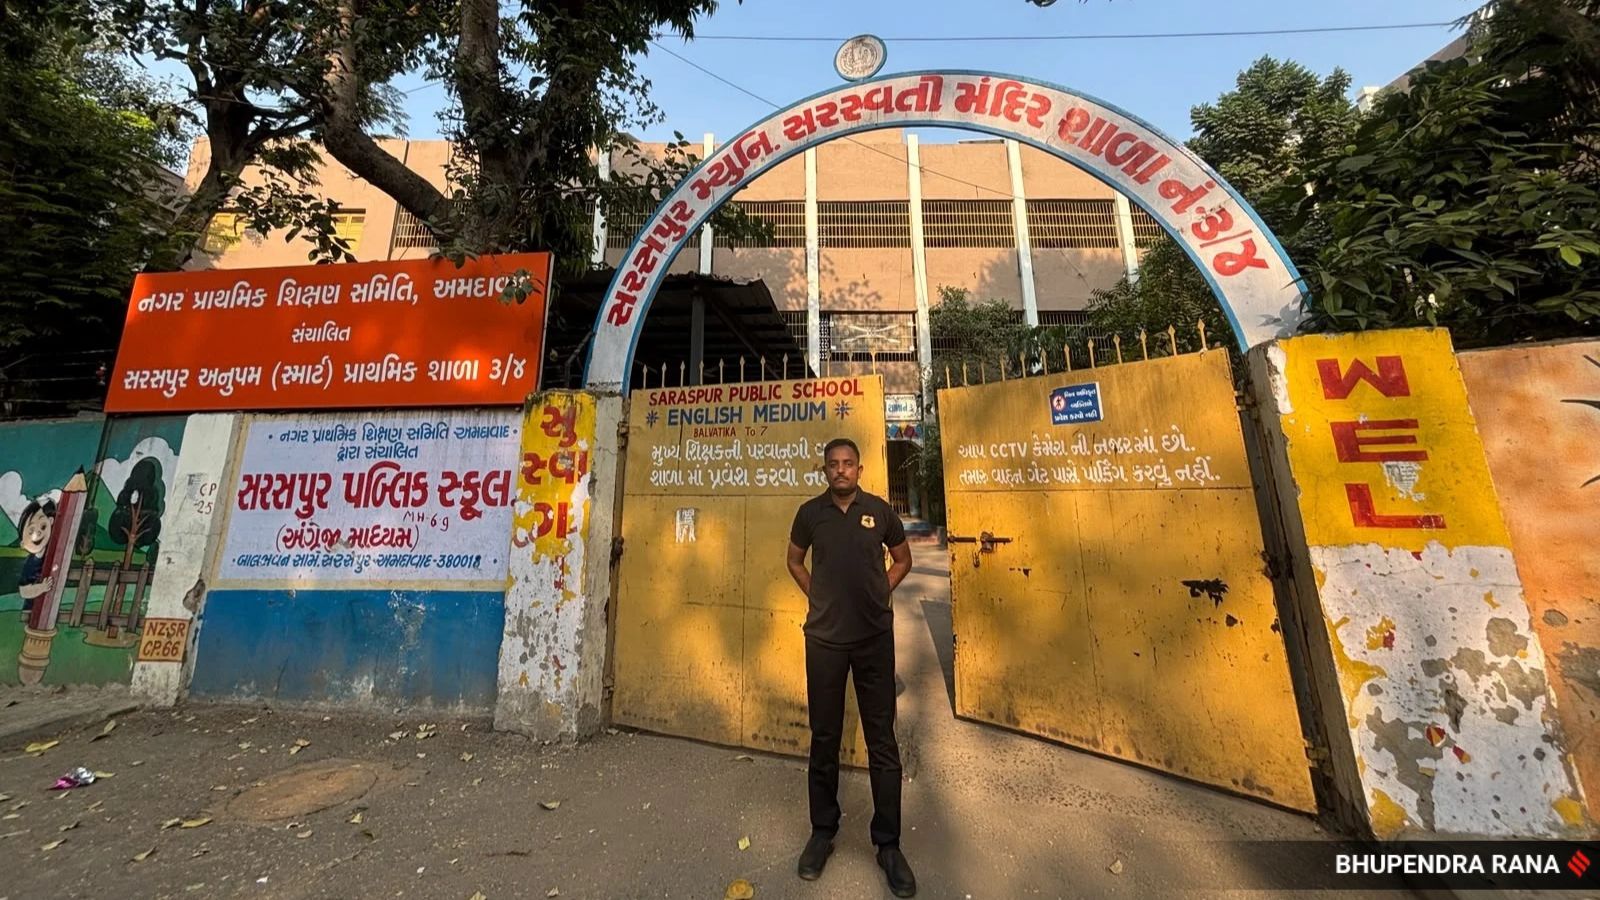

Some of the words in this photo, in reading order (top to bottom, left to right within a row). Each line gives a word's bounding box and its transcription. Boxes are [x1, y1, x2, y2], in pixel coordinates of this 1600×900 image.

[606, 200, 695, 327] સરસપુર
[690, 130, 781, 200] મ્યુનિ.
[782, 75, 945, 142] સરસ્વતી
[954, 77, 1052, 129] મંદિર
[1057, 107, 1172, 186] શાળા
[138, 291, 185, 312] નગર
[192, 281, 268, 311] પ્રાથમિક
[276, 278, 341, 308] શિક્ષણ
[350, 272, 418, 305] સમિતિ,
[291, 320, 351, 343] સંચાલિત
[123, 368, 189, 398] સરસપુર
[198, 365, 262, 396] અનુપમ
[271, 355, 333, 391] (સ્માર્ટ)
[343, 353, 418, 383] પ્રાથમિક
[427, 359, 479, 381] શાળા
[488, 352, 527, 386] ૩/૪
[648, 387, 723, 406] SARASPUR
[728, 384, 782, 402] PUBLIC
[792, 379, 864, 400] SCHOOL
[667, 406, 742, 426] ENGLISH
[753, 401, 826, 423] MEDIUM
[280, 429, 308, 443] નગર
[312, 424, 356, 443] પ્રાથમિક
[362, 422, 400, 443] શિક્ષણ
[406, 421, 450, 440] સમિતિ
[694, 426, 737, 438] BALVATIKA
[745, 426, 756, 436] To
[760, 426, 768, 436] 7
[364, 443, 418, 459] સંચાલિત
[651, 444, 682, 466] મુખ્ય
[685, 439, 743, 465] શિક્ષકની
[746, 437, 810, 460] પરવાનગી
[958, 443, 987, 458] આપ
[990, 442, 1027, 458] CCTV
[649, 468, 685, 487] શાળા
[707, 462, 750, 489] પ્રવેશ
[754, 461, 798, 487] કરવો
[991, 467, 1025, 488] વાહન
[1027, 461, 1049, 484] ગેટ
[1051, 459, 1081, 484] પાસે
[200, 482, 217, 496] CP
[237, 473, 332, 519] સરસપુર
[342, 461, 428, 508] પબ્લિક
